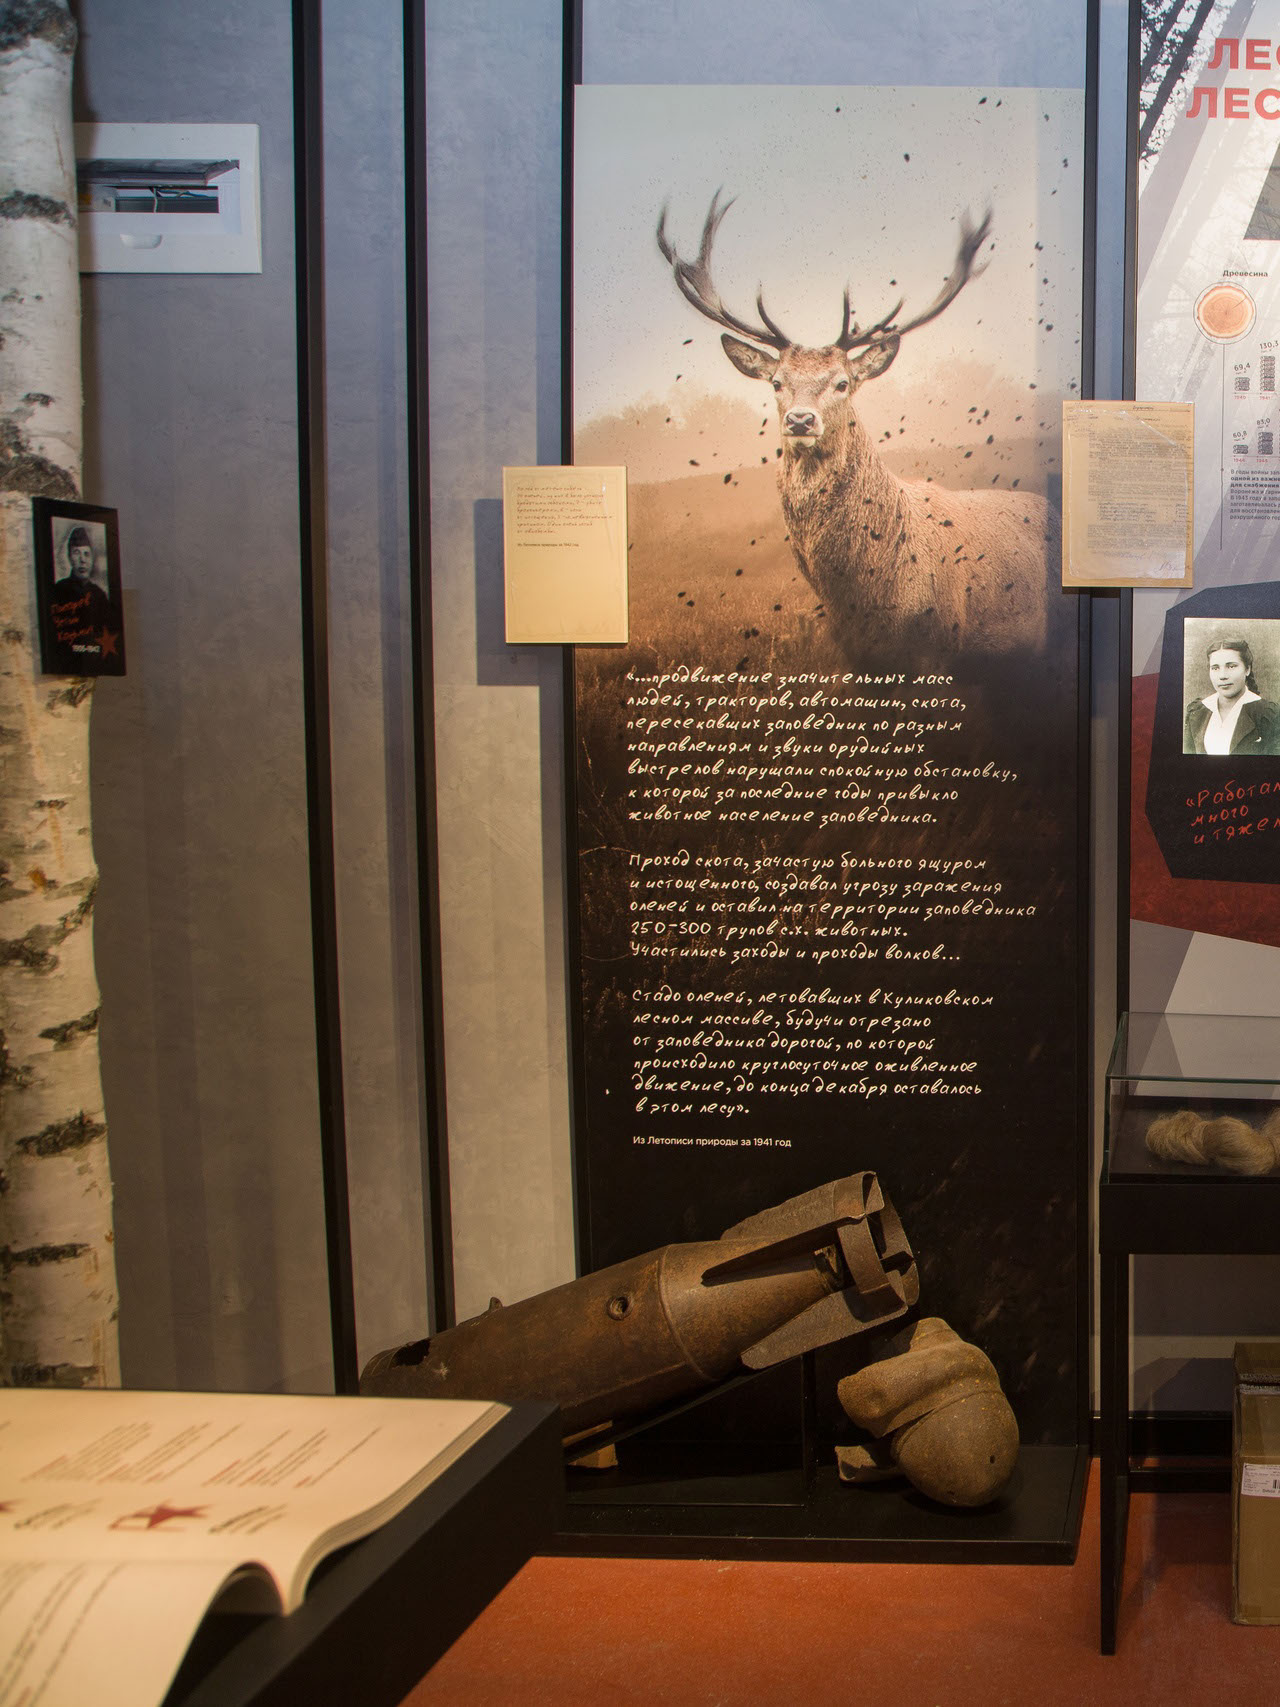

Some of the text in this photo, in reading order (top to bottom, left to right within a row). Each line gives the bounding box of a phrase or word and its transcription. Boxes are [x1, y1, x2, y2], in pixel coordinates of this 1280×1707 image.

[1223, 270, 1269, 278] Древесина
[1259, 340, 1279, 350] 130,3
[1234, 362, 1251, 372] 69,4
[626, 665, 953, 690] «...продвижение значительных масс
[627, 688, 966, 712] людей, тракторов, автомашин, скота,
[627, 713, 961, 737] пересекавших заповедник по разным
[628, 737, 751, 757] направлениям
[773, 737, 822, 759] звуки
[829, 736, 924, 759] орудийных
[628, 758, 1017, 782] выстрелов нарушали спокойную обстановку,
[644, 787, 710, 803] которой
[715, 788, 735, 804] за
[741, 782, 827, 798] последние
[835, 782, 871, 799] годы
[878, 784, 958, 805] привыкло
[629, 805, 936, 829] животное население заповедника.
[1191, 806, 1248, 826] много
[1194, 834, 1204, 844] и
[629, 849, 986, 874] Проход скота, зачастую больного ящуром
[646, 879, 759, 892] истощенного,
[765, 873, 836, 896] создавал
[843, 882, 897, 898] угрозу
[902, 882, 1001, 898] заражения
[630, 901, 689, 912] оленей
[712, 898, 776, 912] оставил
[783, 904, 803, 912] на
[809, 903, 919, 919] территории
[924, 898, 1036, 921] заповедника
[632, 919, 907, 940] 250-300 трупов с.х. животных.
[630, 942, 726, 958] Участились
[731, 941, 789, 964] заходы
[812, 942, 878, 964] проходы
[885, 944, 959, 960] волков...
[633, 1136, 645, 1144] Из
[647, 1136, 693, 1145] Летописи
[754, 1138, 772, 1146] 1941
